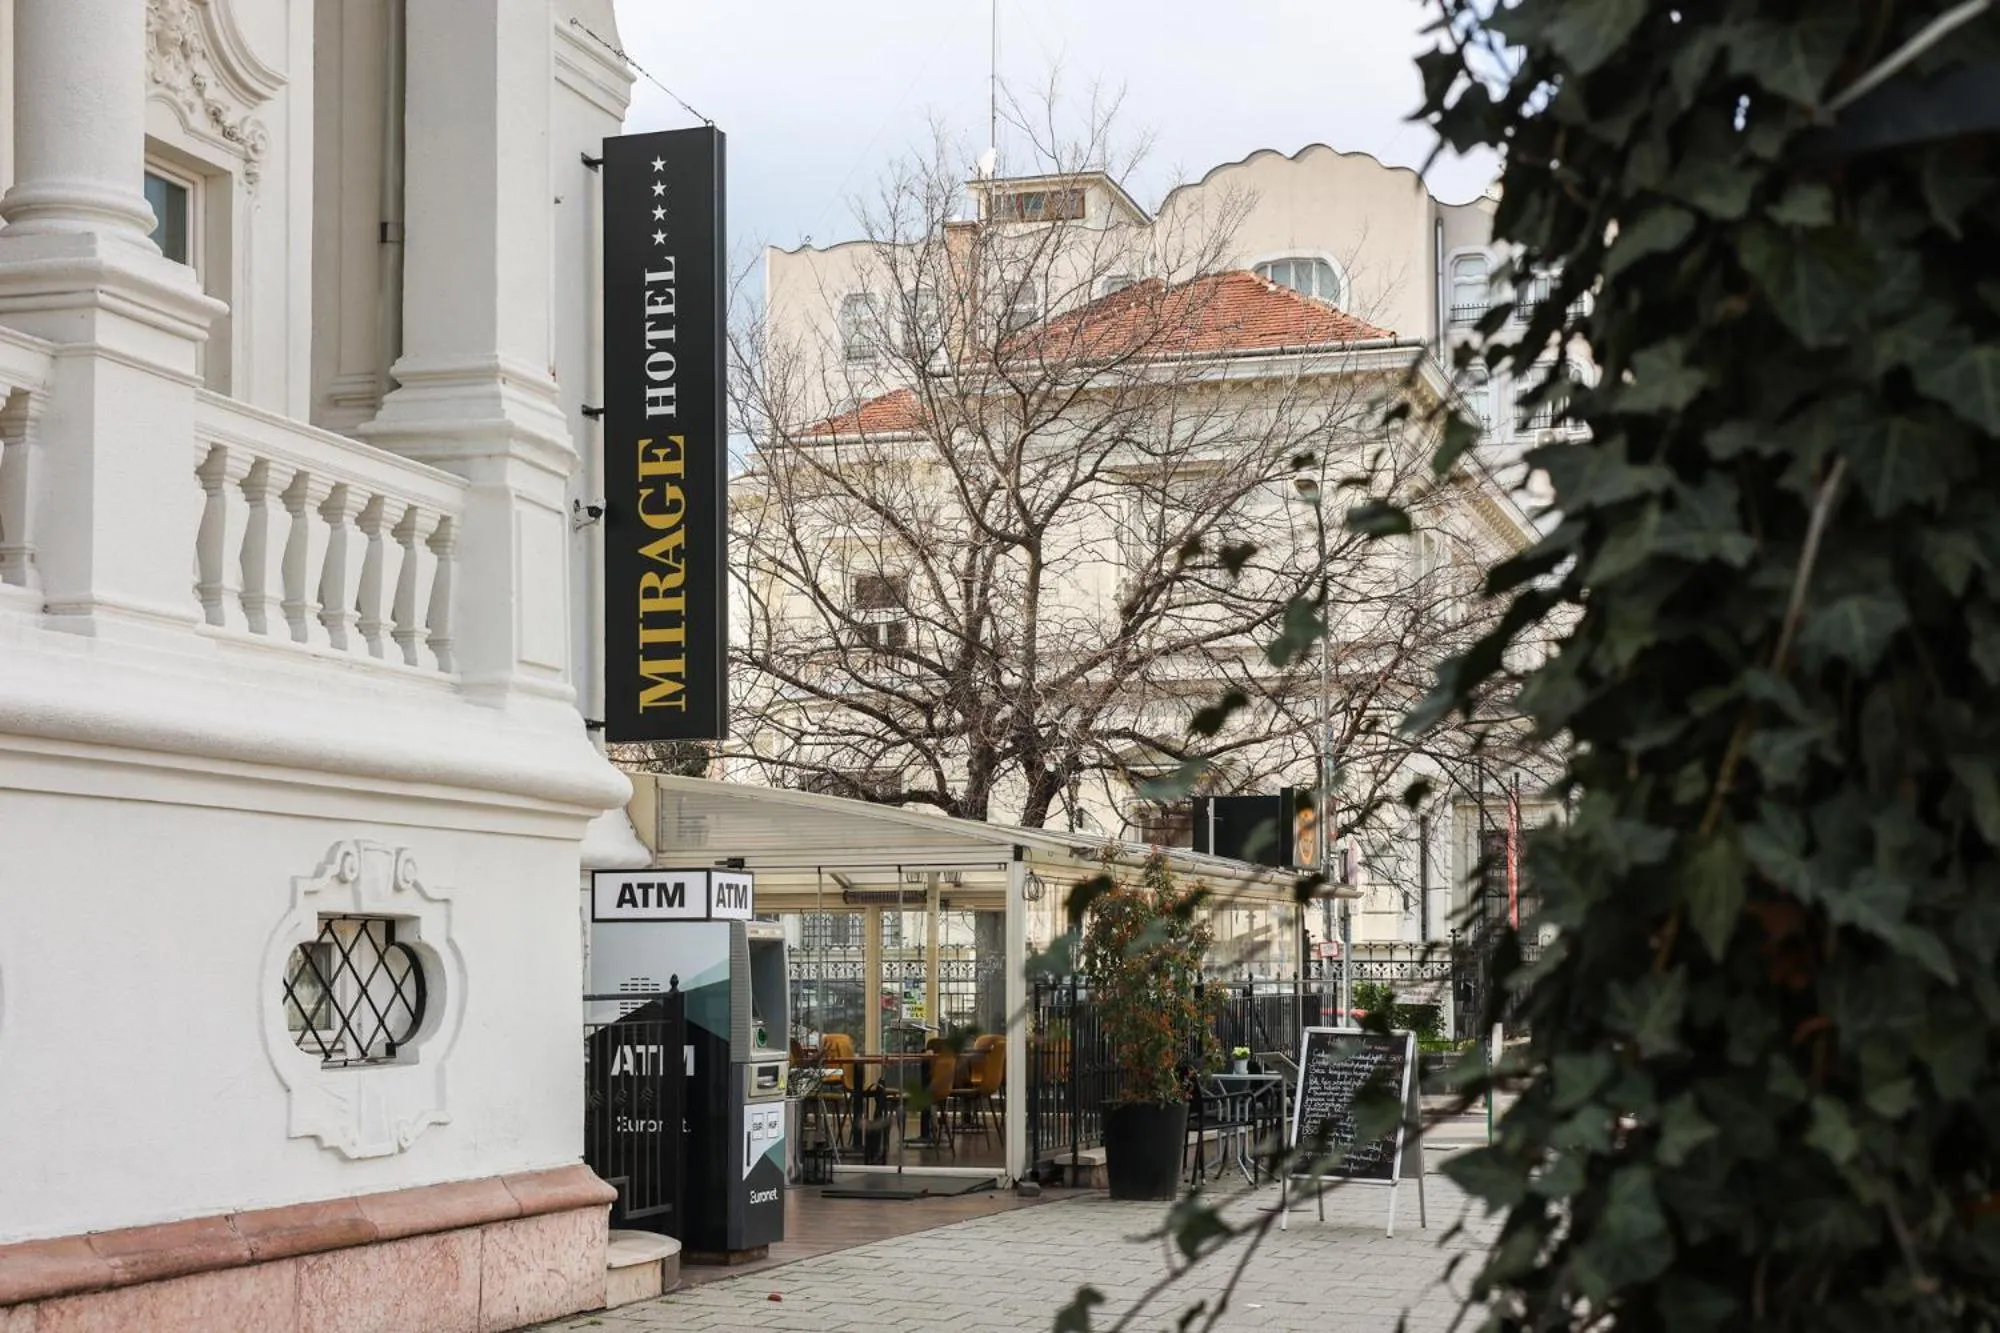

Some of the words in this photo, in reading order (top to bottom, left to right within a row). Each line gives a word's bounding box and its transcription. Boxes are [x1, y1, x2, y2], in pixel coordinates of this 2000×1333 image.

[644, 255, 677, 420] HOTEL
[637, 434, 687, 714] MIRAGE
[616, 882, 685, 909] ATM
[716, 882, 748, 909] ATM
